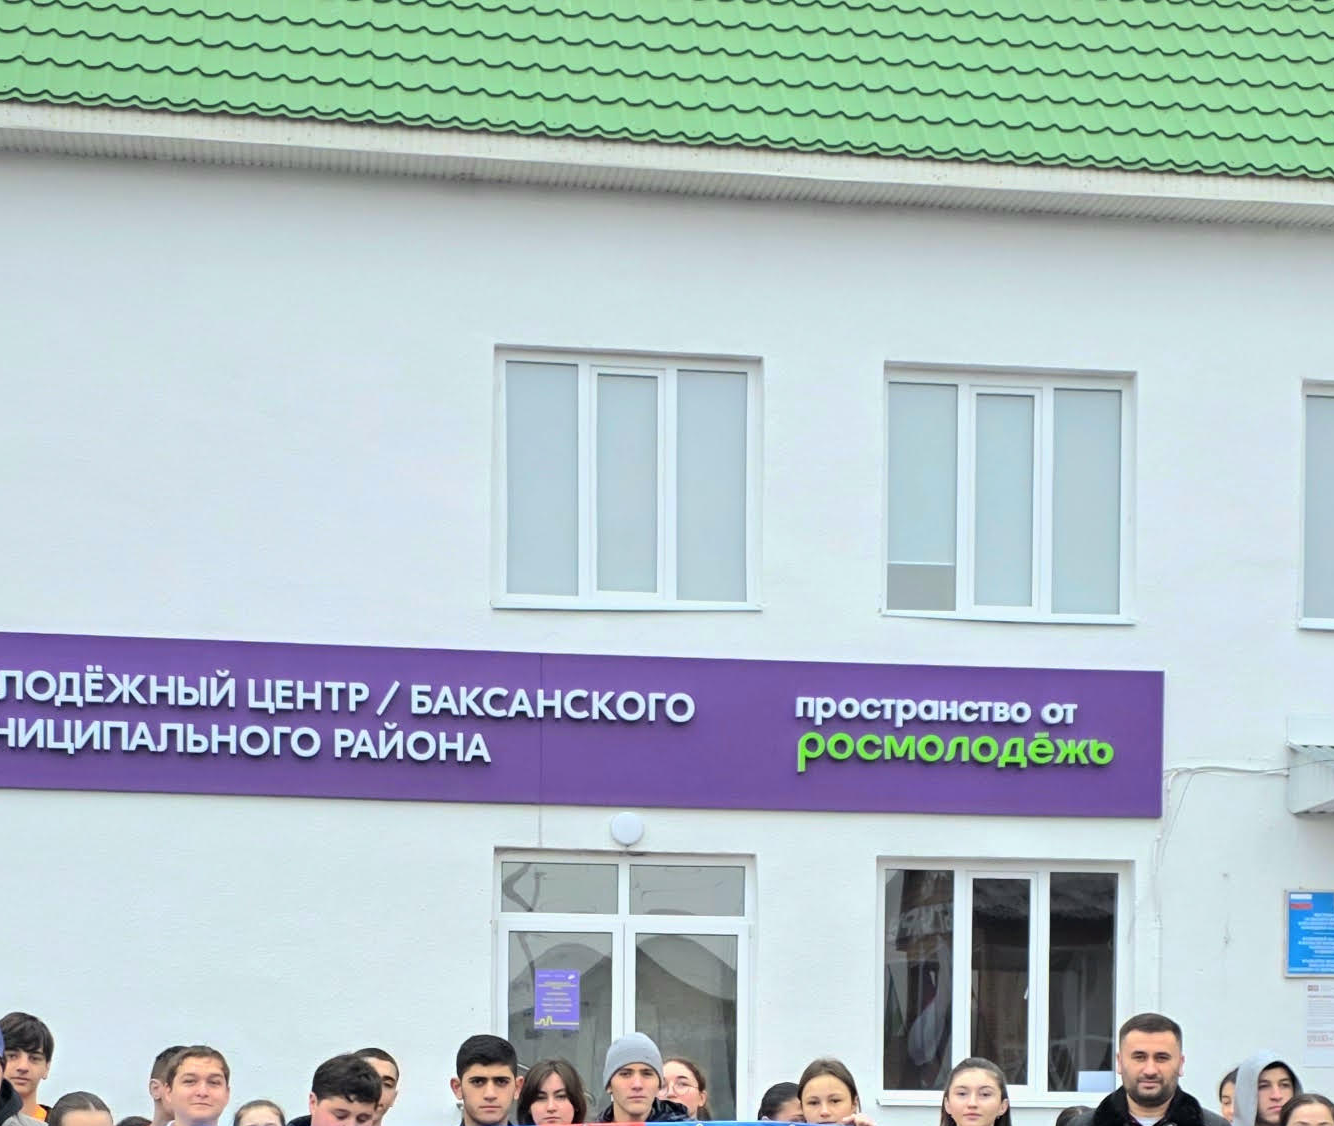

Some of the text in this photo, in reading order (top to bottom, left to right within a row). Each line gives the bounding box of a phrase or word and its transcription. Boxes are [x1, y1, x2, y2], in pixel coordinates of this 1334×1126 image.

[247, 678, 370, 715] ЦЕНТР
[411, 684, 696, 723] БАКСАНСКОГО
[794, 695, 1079, 728] пространство от
[333, 721, 492, 763] РАЙОНА
[796, 730, 1115, 773] росмолодёжь
